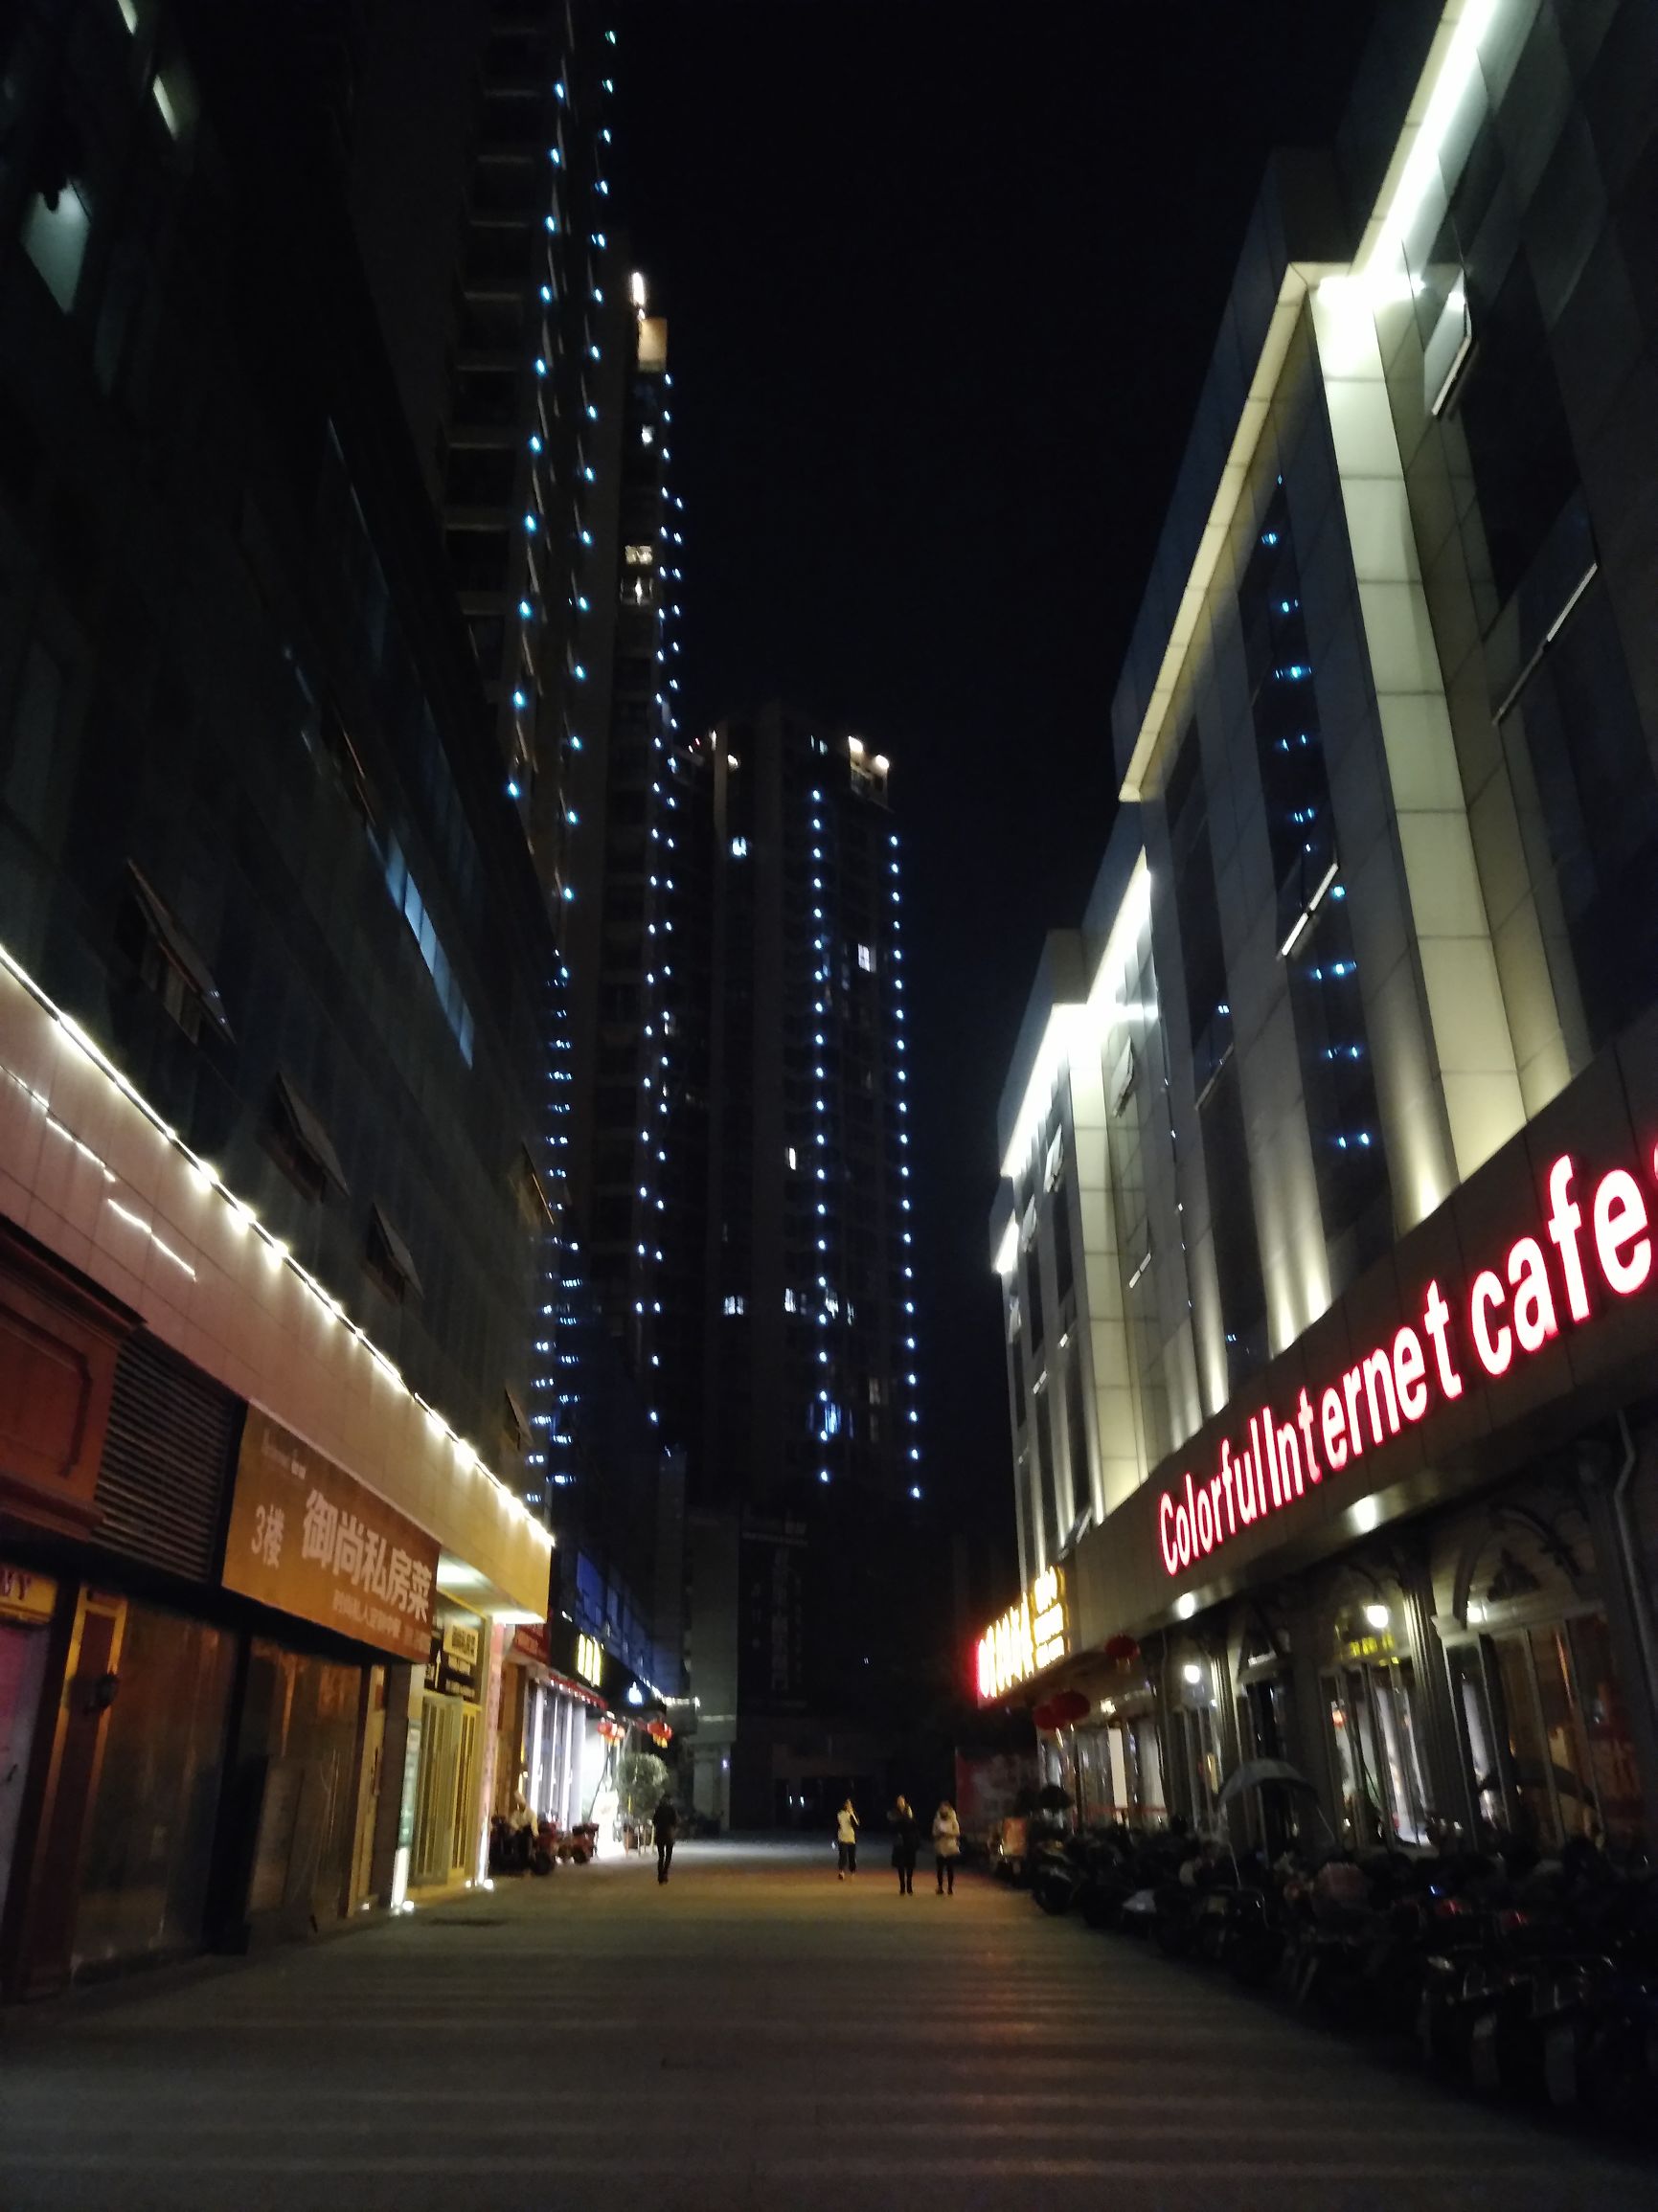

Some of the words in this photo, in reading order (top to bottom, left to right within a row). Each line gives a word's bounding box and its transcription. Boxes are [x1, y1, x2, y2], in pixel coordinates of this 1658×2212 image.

[1160, 1416, 1267, 1576] Colorful
[1470, 1154, 1653, 1376] cafe
[302, 1488, 431, 1622] 御尚私房菜
